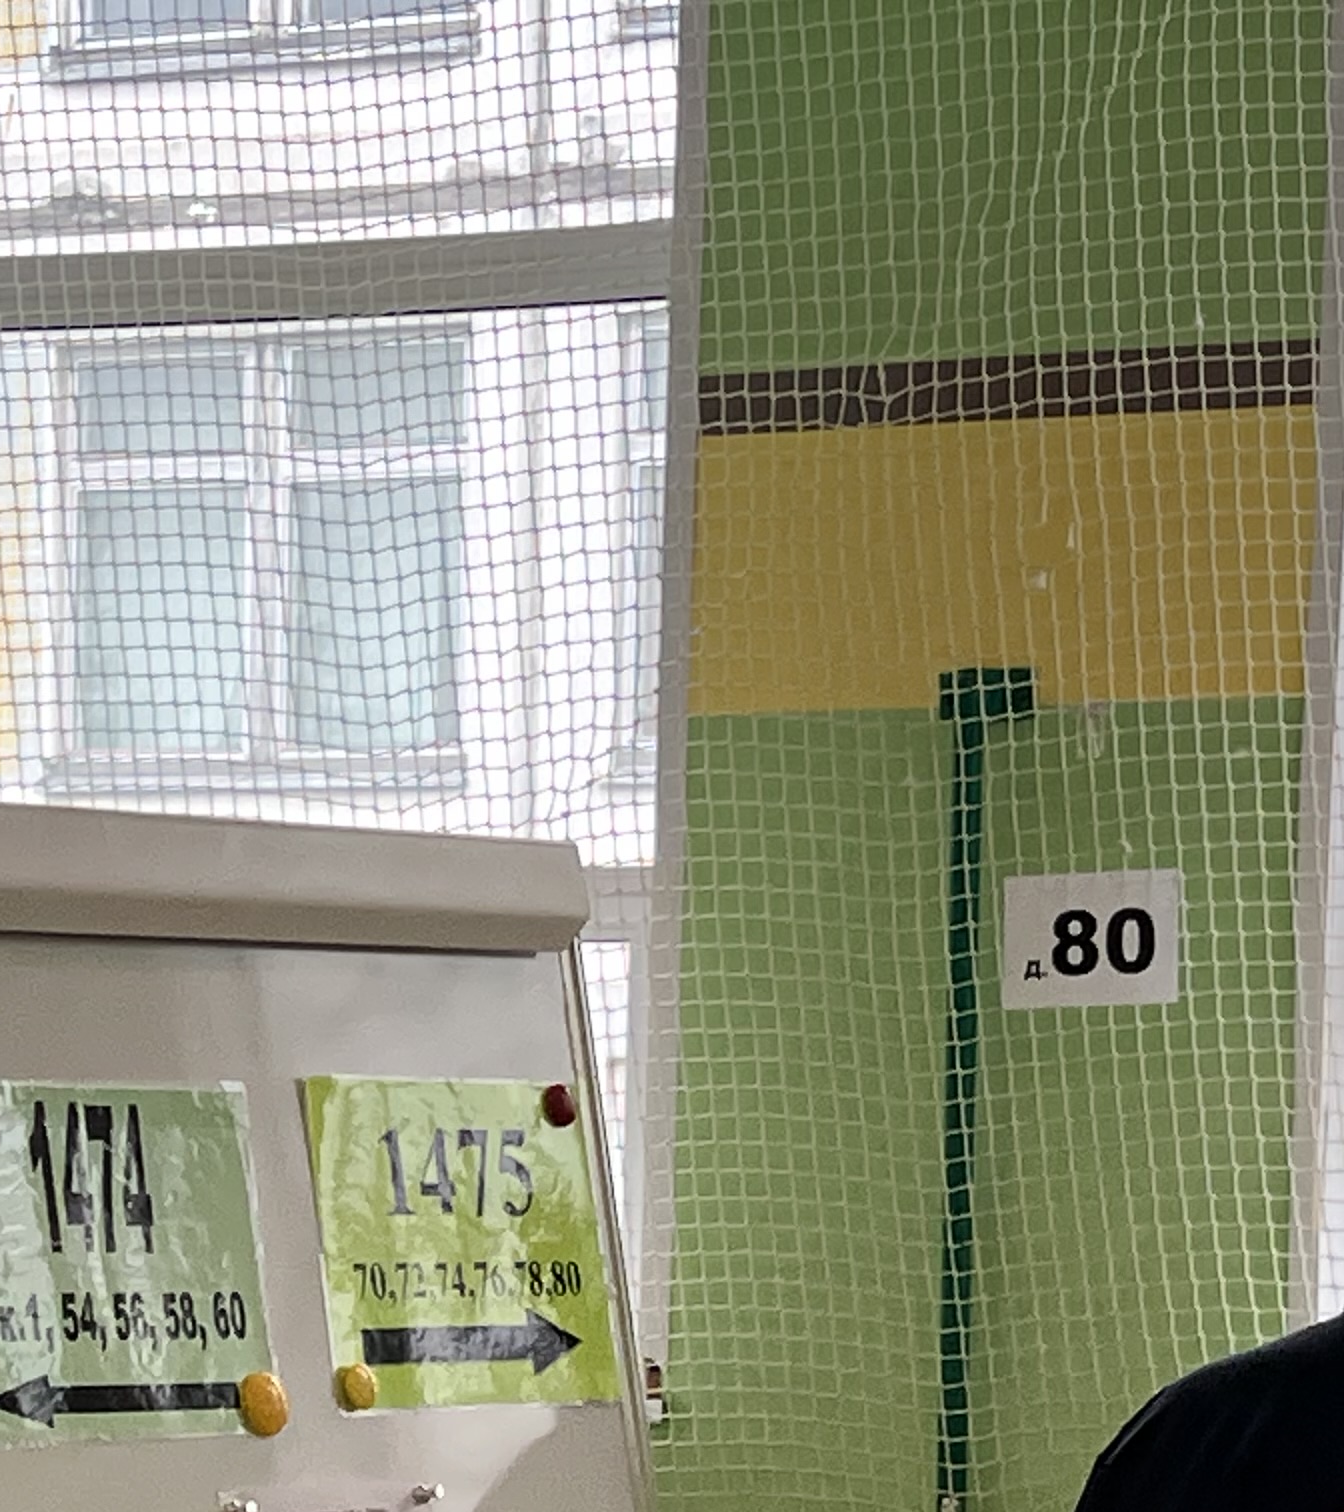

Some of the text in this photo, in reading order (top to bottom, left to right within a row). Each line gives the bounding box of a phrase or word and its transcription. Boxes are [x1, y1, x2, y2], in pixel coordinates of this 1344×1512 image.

[29, 1101, 155, 1254] 1474
[378, 1128, 533, 1217] 1475
[61, 1292, 107, 1353] 54,
[162, 1292, 206, 1351] 58,
[213, 1291, 247, 1340] 60
